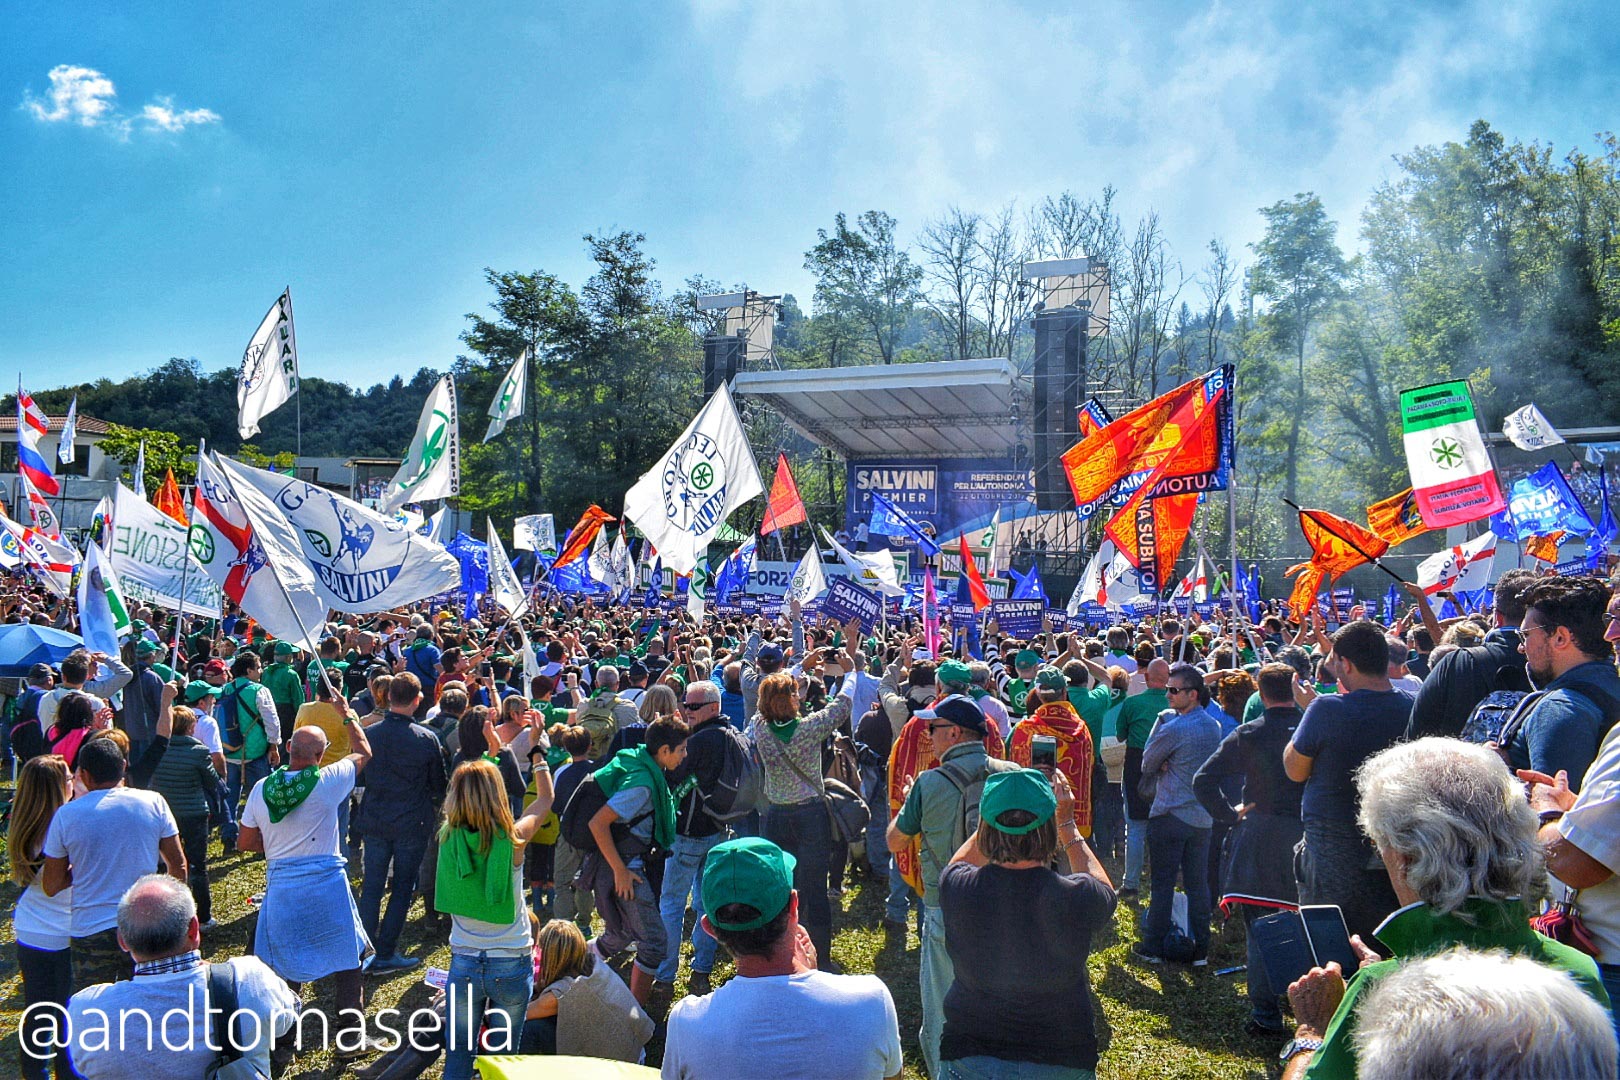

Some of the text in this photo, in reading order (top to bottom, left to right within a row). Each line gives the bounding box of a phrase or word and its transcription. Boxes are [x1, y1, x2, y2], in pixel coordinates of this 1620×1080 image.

[450, 433, 458, 493] VARESINO
[857, 470, 935, 490] SALVINI
[863, 493, 926, 502] PEMIER
[320, 566, 390, 602] SALVINI
[747, 570, 790, 587] FORZ
[834, 584, 877, 615] SALVINI
[835, 597, 871, 619] PREMIER
[952, 605, 974, 613] SALVINI
[995, 602, 1042, 612] SALVINI
